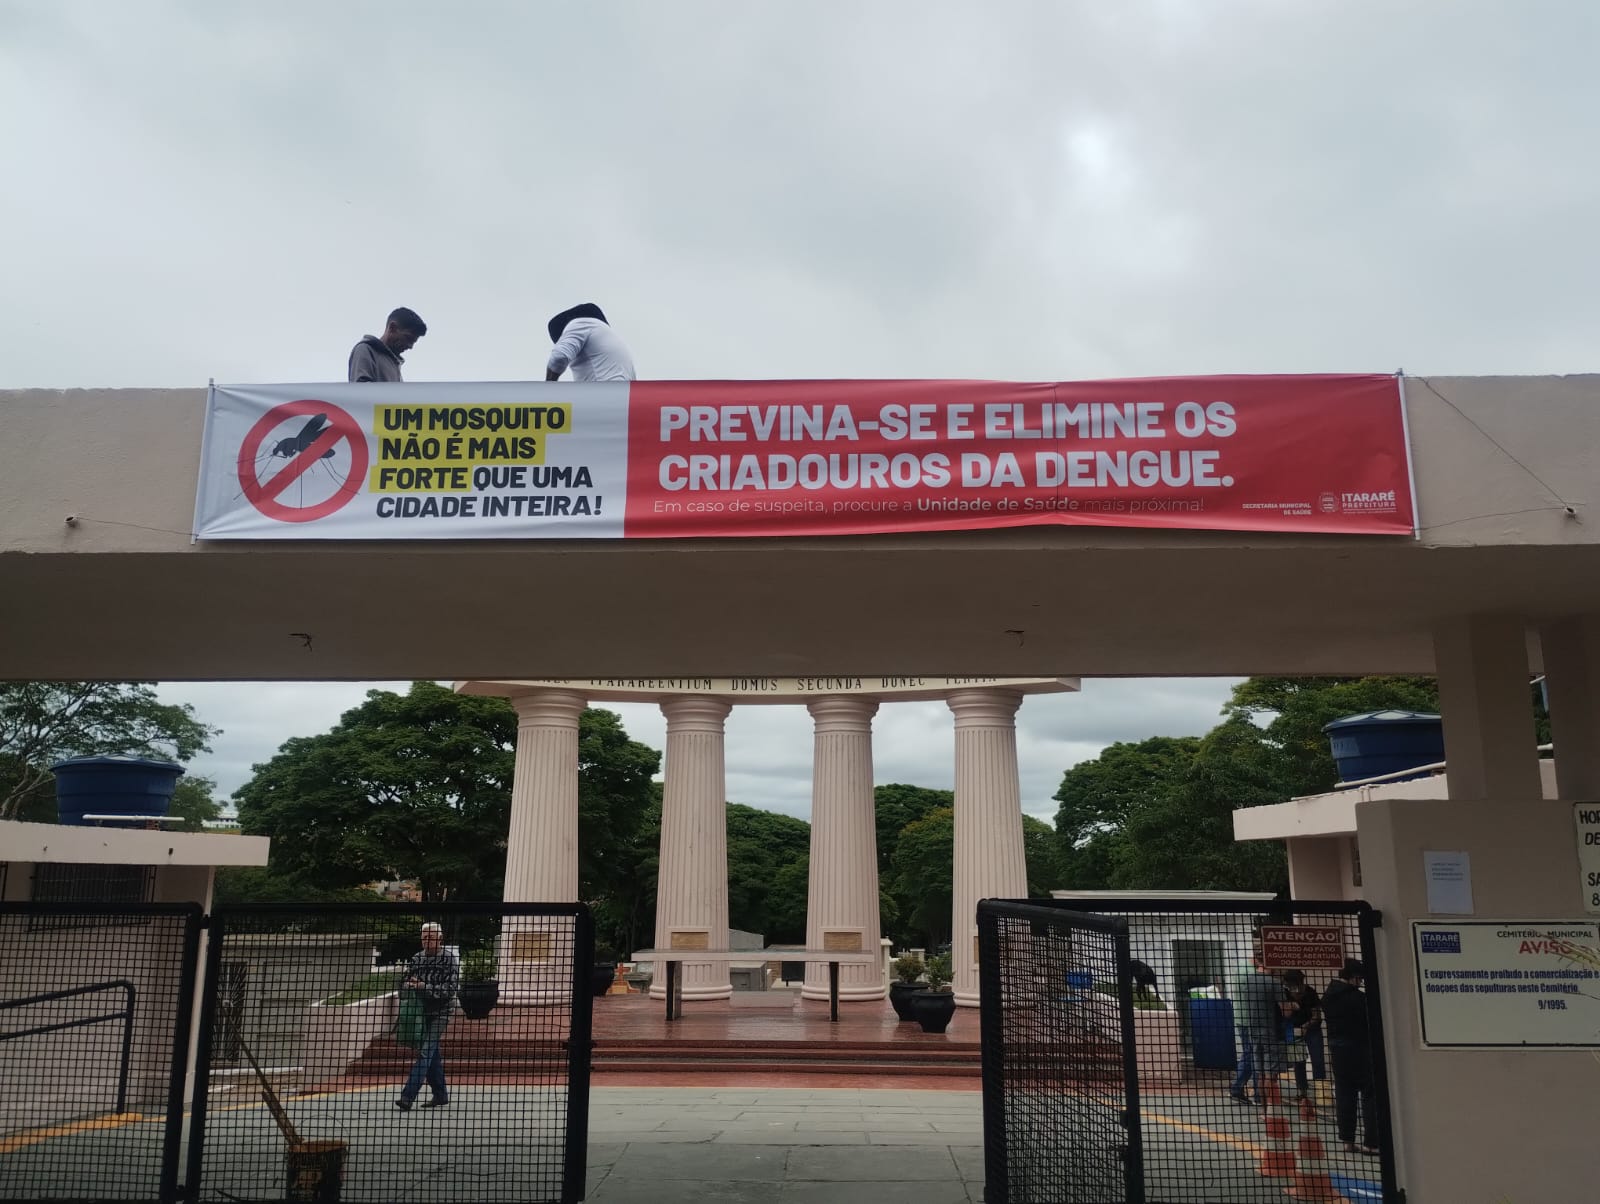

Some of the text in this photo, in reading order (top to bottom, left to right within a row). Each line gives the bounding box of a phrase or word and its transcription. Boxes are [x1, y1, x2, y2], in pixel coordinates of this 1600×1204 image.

[383, 406, 565, 433] UM MOSQUITO
[659, 401, 1237, 442] PREVINA-SE E ELIMINE OS
[382, 432, 536, 460] NÃO É MAIS
[379, 466, 593, 490] FORTE QUE UMA
[658, 450, 1234, 492] CRIADOUROS DA DENGUE.
[1341, 490, 1396, 502] ITARARÉ
[1342, 501, 1396, 509] PREFEITURA
[376, 495, 602, 518] CIDADE INTEIRA!
[653, 497, 1205, 515] Em caso de suspeita, procure a Unidade de Saúde mais próxima!
[731, 679, 778, 691] DOMUS
[797, 678, 862, 691] SECUNDA
[1547, 930, 1593, 938] MUNICIPAL
[1430, 969, 1489, 979] expressamente
[1490, 969, 1522, 979] proibido
[1523, 970, 1528, 979] a
[1530, 968, 1593, 980] comercialização
[1460, 983, 1474, 993] das
[1475, 983, 1516, 994] sepulturas
[1518, 983, 1539, 993] neste
